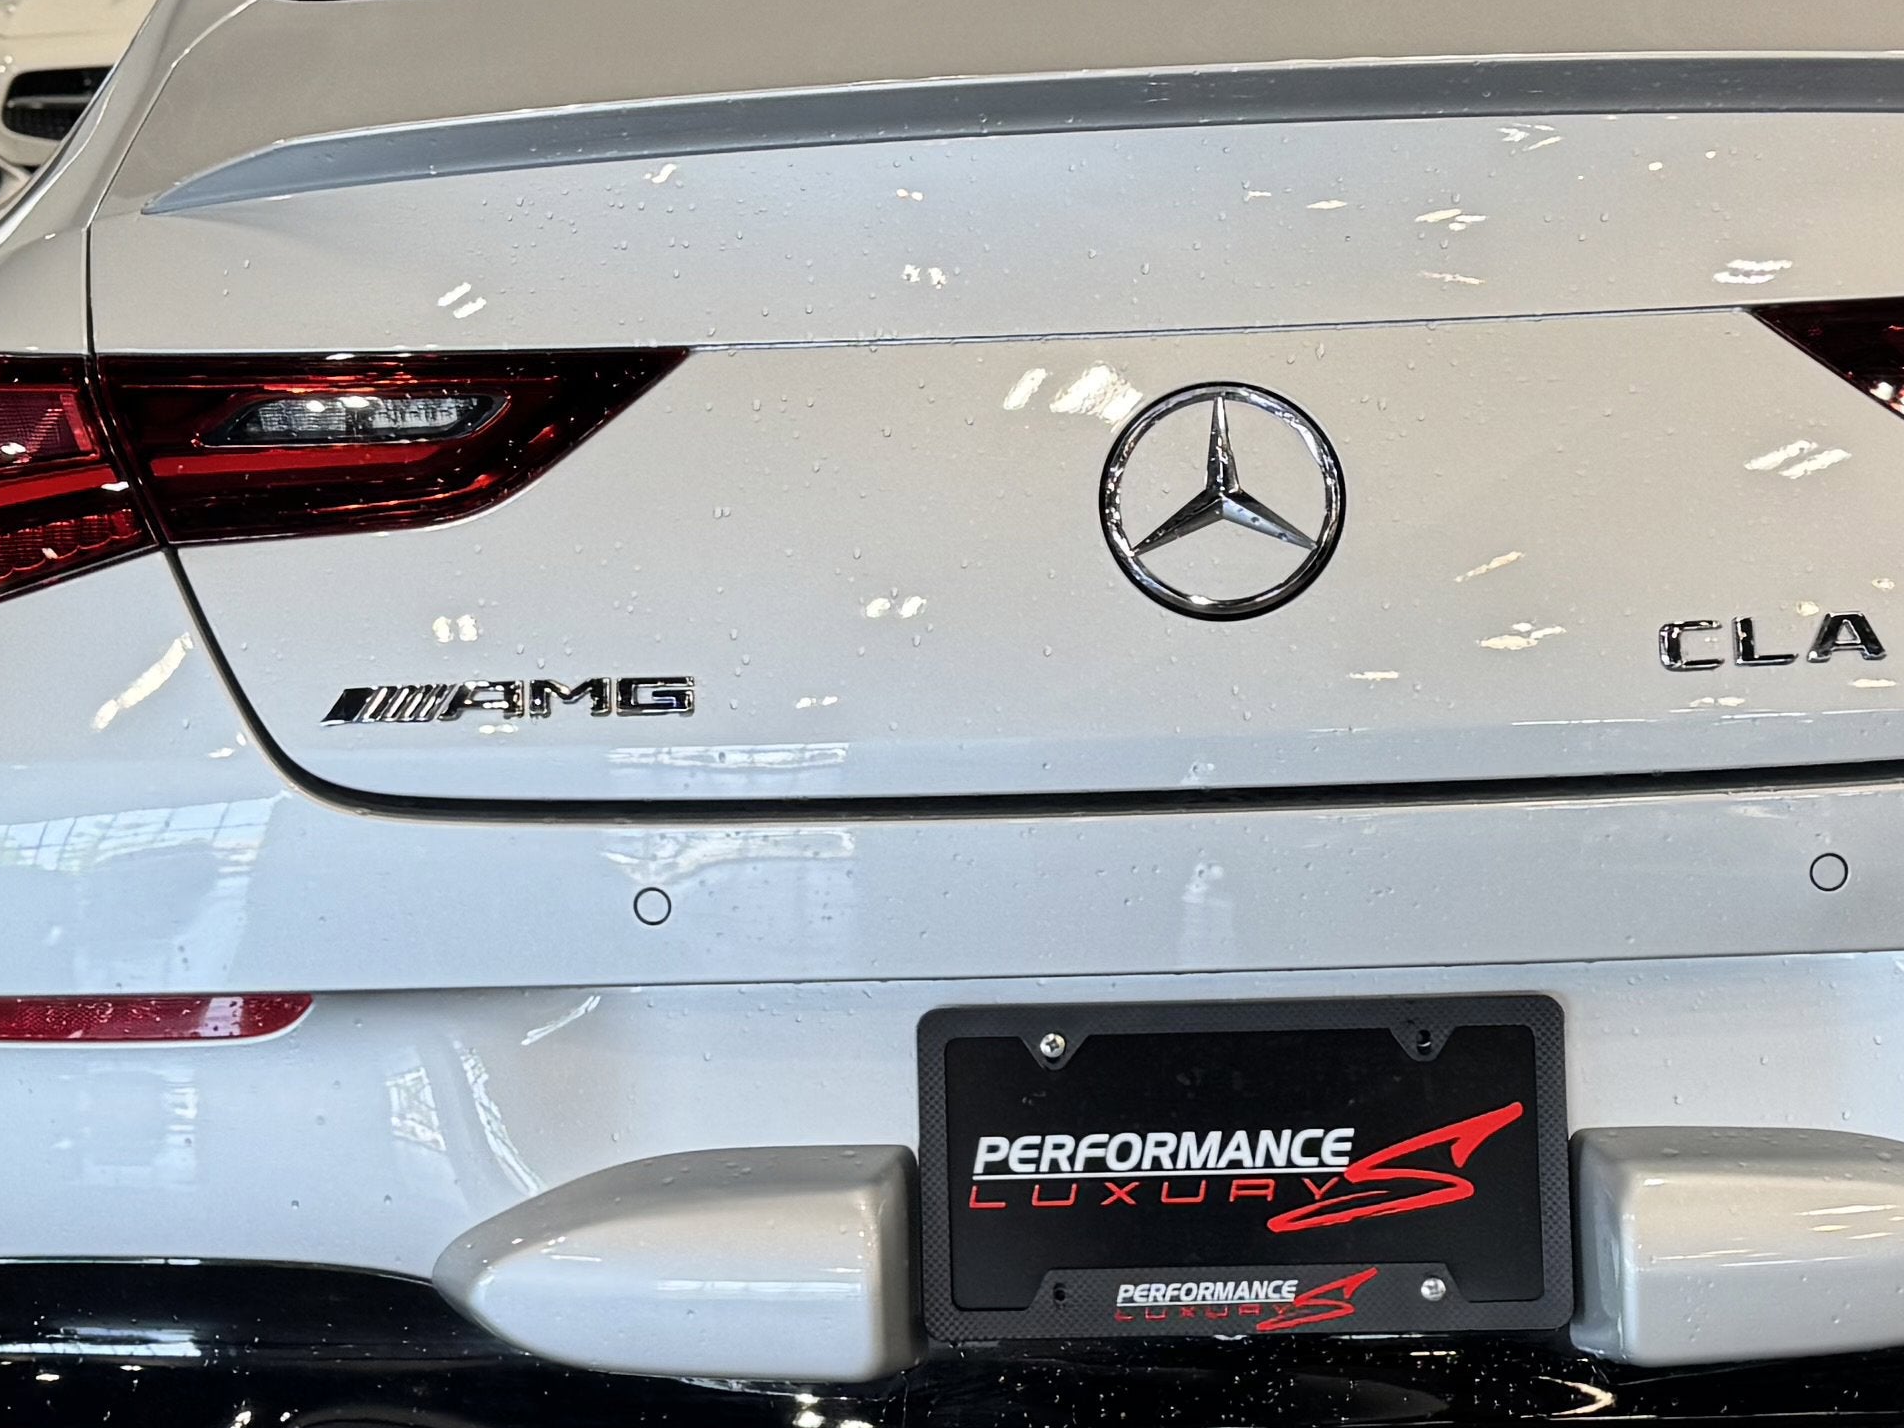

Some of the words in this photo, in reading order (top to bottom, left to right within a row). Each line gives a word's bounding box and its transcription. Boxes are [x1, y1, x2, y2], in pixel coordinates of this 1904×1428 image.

[1657, 610, 1887, 671] CLA
[972, 1126, 1356, 1174] PERFORMANCE
[968, 1176, 1345, 1210] LUXURY
[1116, 1279, 1299, 1304] PERFORMANCE
